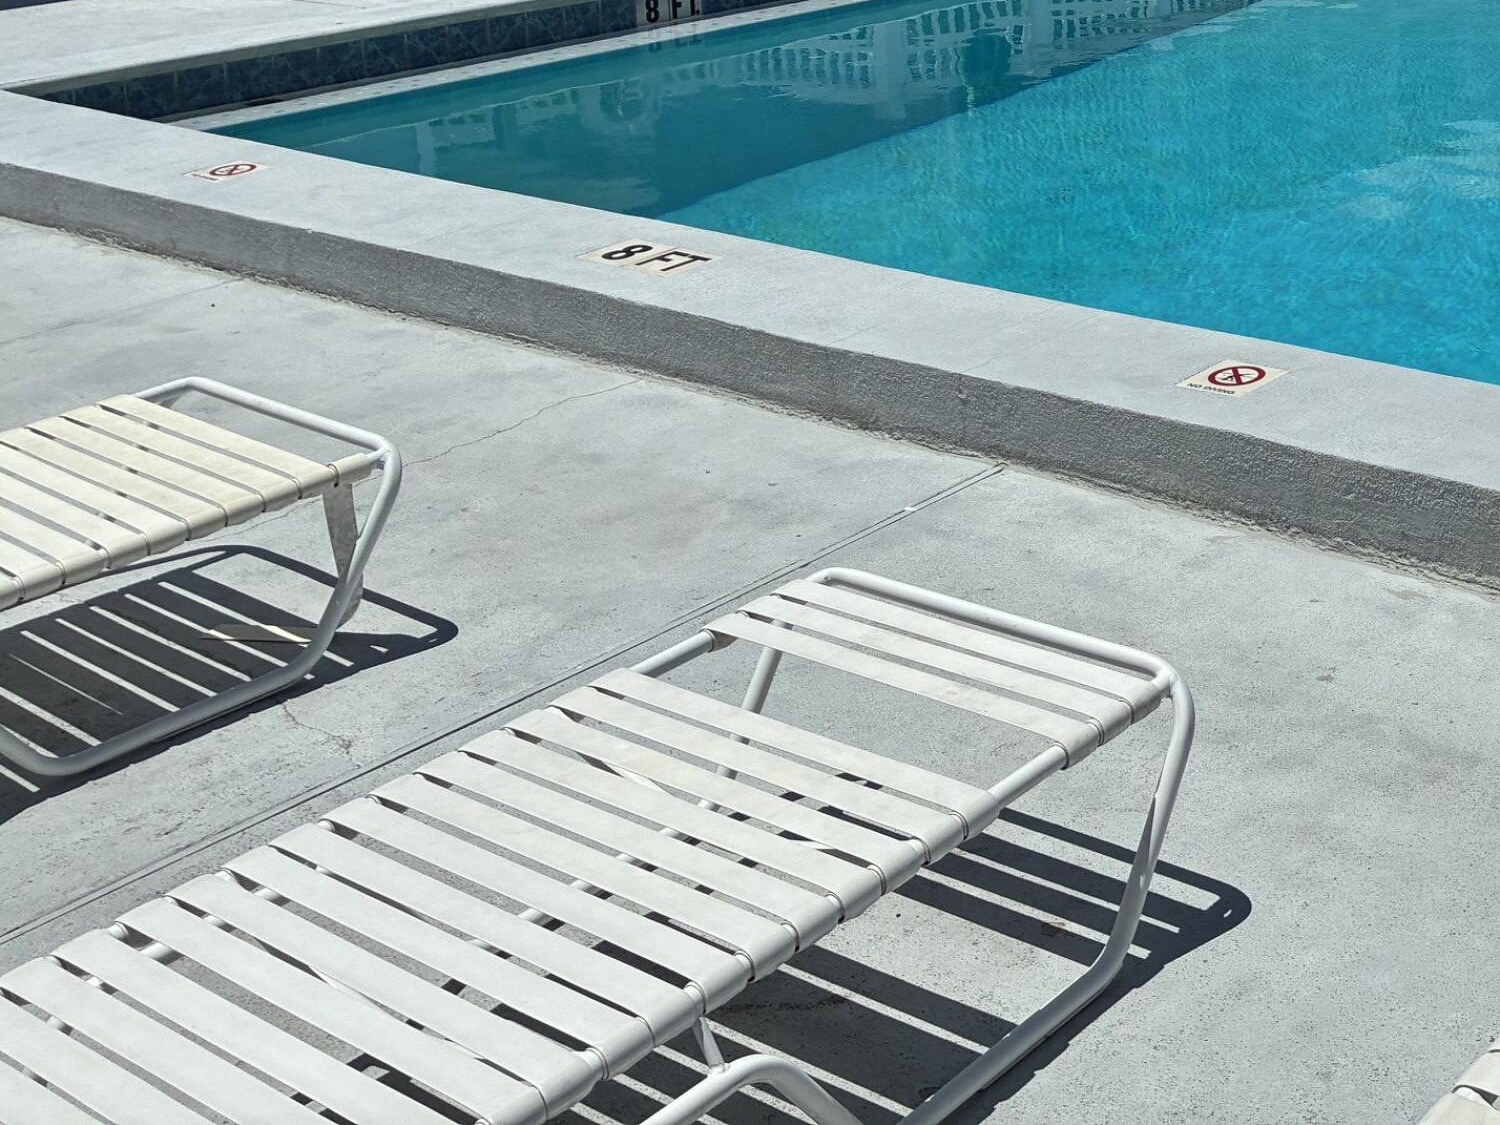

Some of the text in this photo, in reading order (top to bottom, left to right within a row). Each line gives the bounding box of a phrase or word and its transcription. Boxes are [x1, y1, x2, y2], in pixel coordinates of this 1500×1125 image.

[601, 244, 713, 272] 8 FT
[1202, 385, 1236, 395] DIVING
